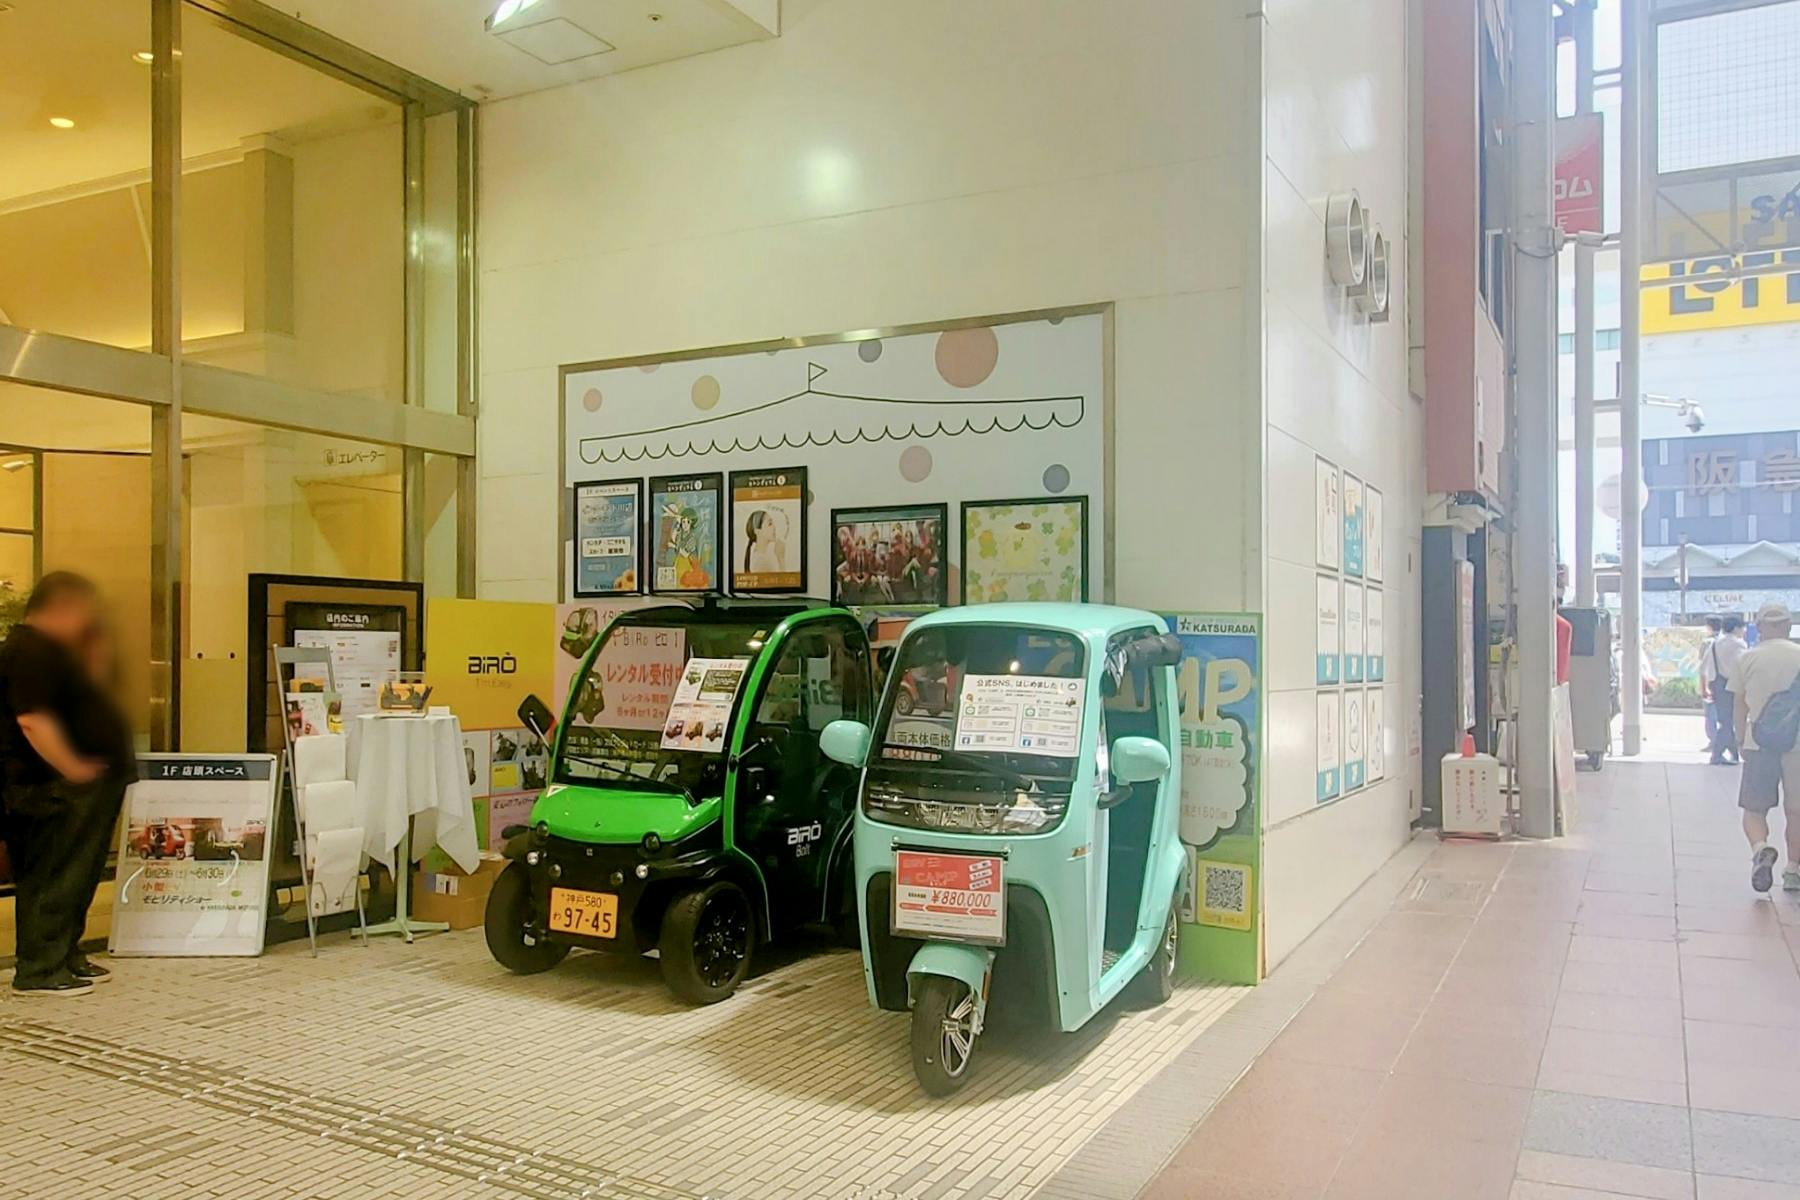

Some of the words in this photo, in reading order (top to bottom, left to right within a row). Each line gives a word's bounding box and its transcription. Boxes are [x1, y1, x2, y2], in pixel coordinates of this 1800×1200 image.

[339, 450, 385, 464] エレベーター
[1193, 623, 1257, 634] KATSURADA
[162, 765, 179, 777] 1F
[182, 765, 245, 777] 店頭スペース
[563, 907, 612, 934] 97-45
